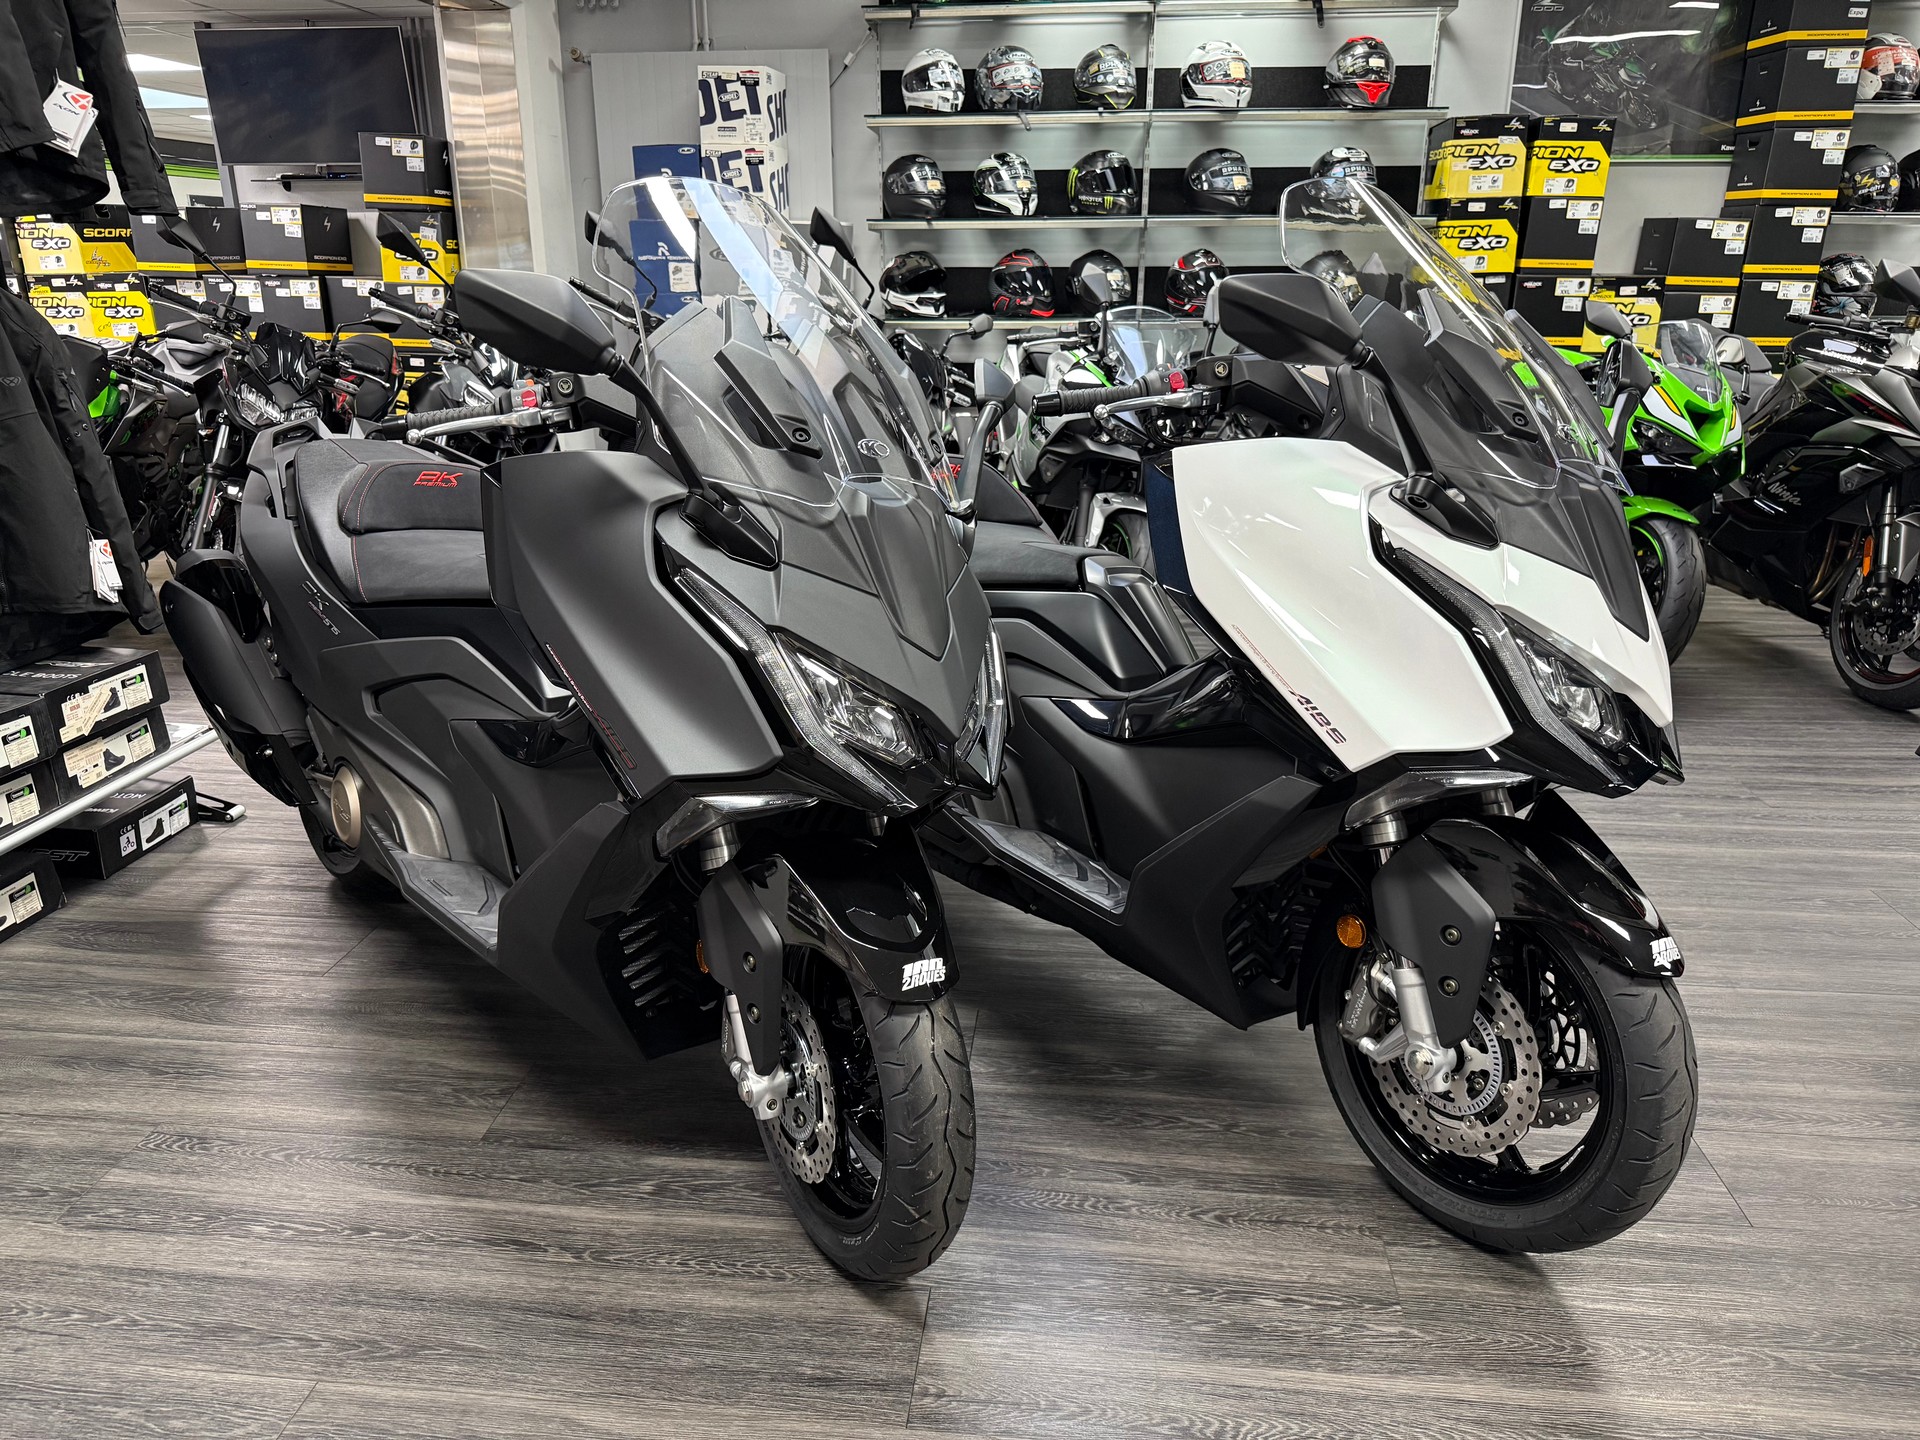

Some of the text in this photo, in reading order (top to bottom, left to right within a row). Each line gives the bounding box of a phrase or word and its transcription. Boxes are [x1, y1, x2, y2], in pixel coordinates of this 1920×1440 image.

[1849, 8, 1864, 16] Expo
[1468, 155, 1516, 169] EXO
[1549, 158, 1599, 173] EXO
[32, 238, 70, 249] EXO
[1458, 237, 1508, 250] EXO
[45, 307, 84, 318] EXO
[105, 307, 143, 318] EXO
[1768, 481, 1802, 505] Ninja
